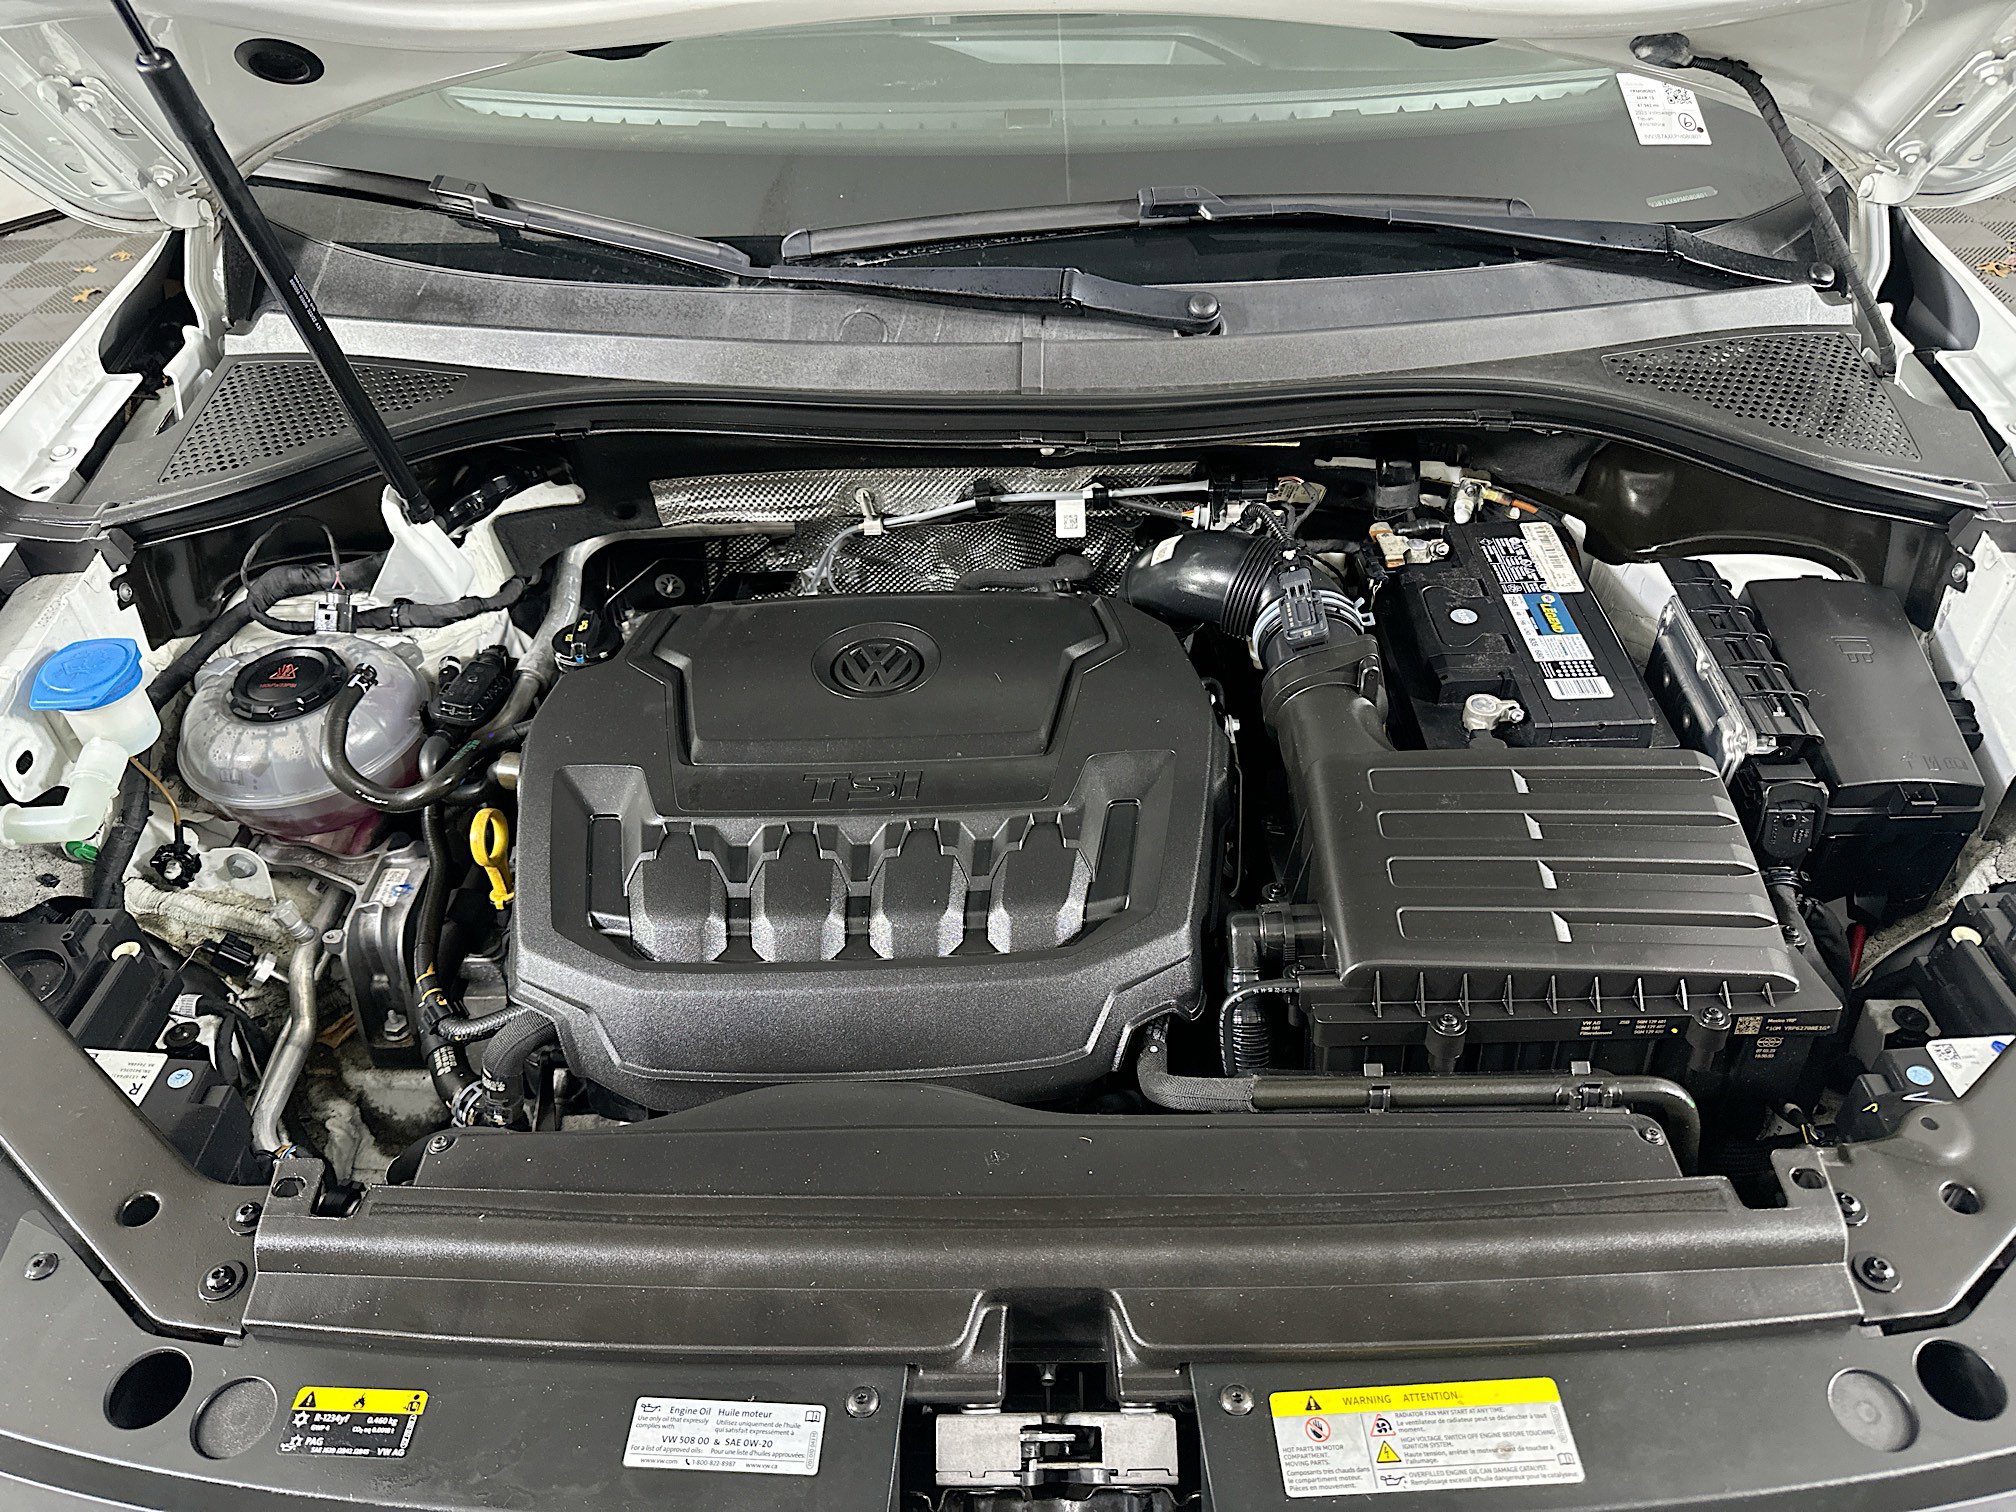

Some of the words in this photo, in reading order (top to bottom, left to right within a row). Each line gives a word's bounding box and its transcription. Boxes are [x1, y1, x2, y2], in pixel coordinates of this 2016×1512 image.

[803, 769, 924, 802] TSI
[1342, 1394, 1392, 1406] WARNING
[1403, 1391, 1458, 1402] ATTENTION
[670, 1406, 698, 1416] Engine
[699, 1407, 712, 1415] Oil
[718, 1408, 740, 1417] Huile
[314, 1413, 351, 1425] R-1234yf
[683, 1417, 709, 1425] expressly
[305, 1437, 324, 1446] PAG
[661, 1435, 678, 1443] VW
[679, 1436, 696, 1444] 508
[697, 1437, 710, 1445] 00
[725, 1438, 742, 1447] SAE
[743, 1439, 774, 1448] 0W-20
[378, 1448, 392, 1456] VW
[391, 1449, 405, 1457] AG
